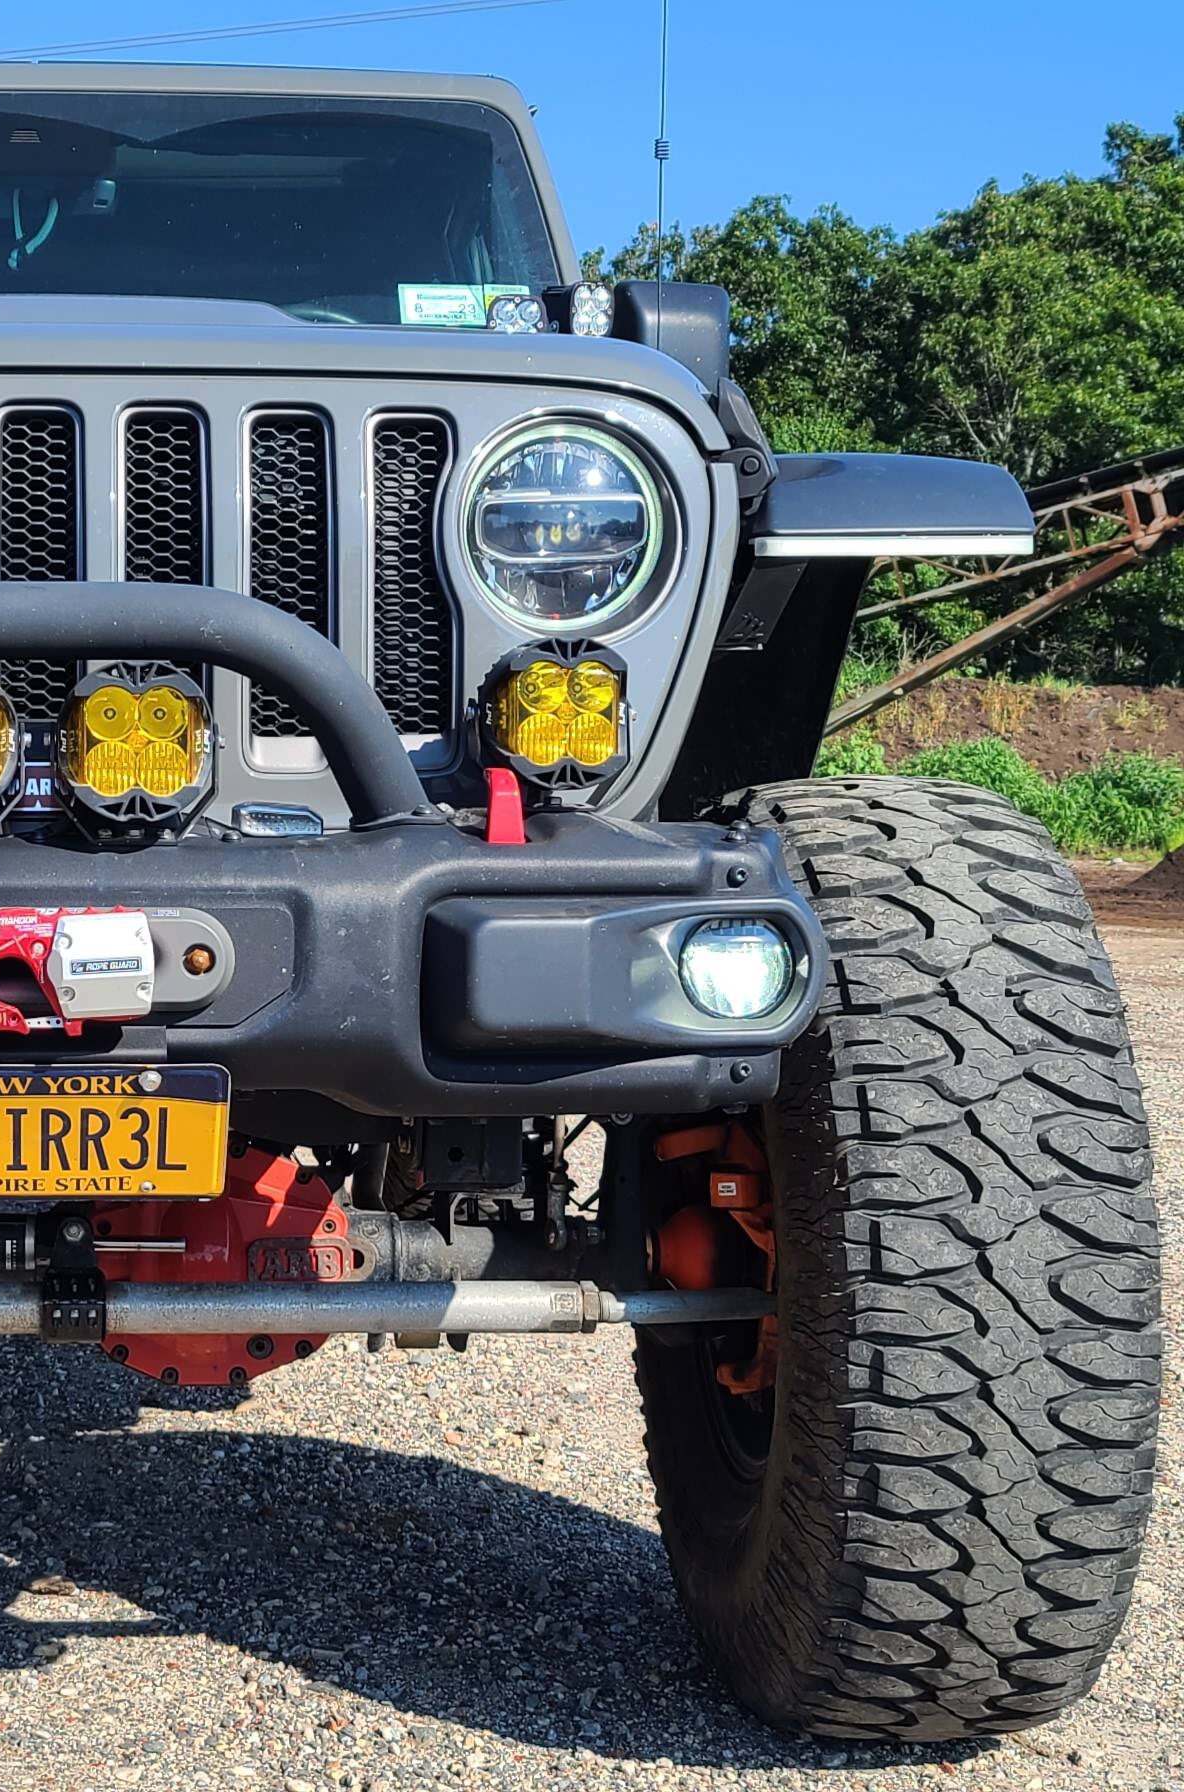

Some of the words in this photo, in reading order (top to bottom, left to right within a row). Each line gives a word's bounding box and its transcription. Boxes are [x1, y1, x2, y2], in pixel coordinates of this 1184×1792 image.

[458, 303, 476, 314] 23
[85, 962, 109, 971] ROPE
[110, 960, 138, 970] GUARD
[42, 1075, 139, 1095] YORK
[55, 1175, 132, 1192] STATE
[260, 1247, 338, 1279] ARB
